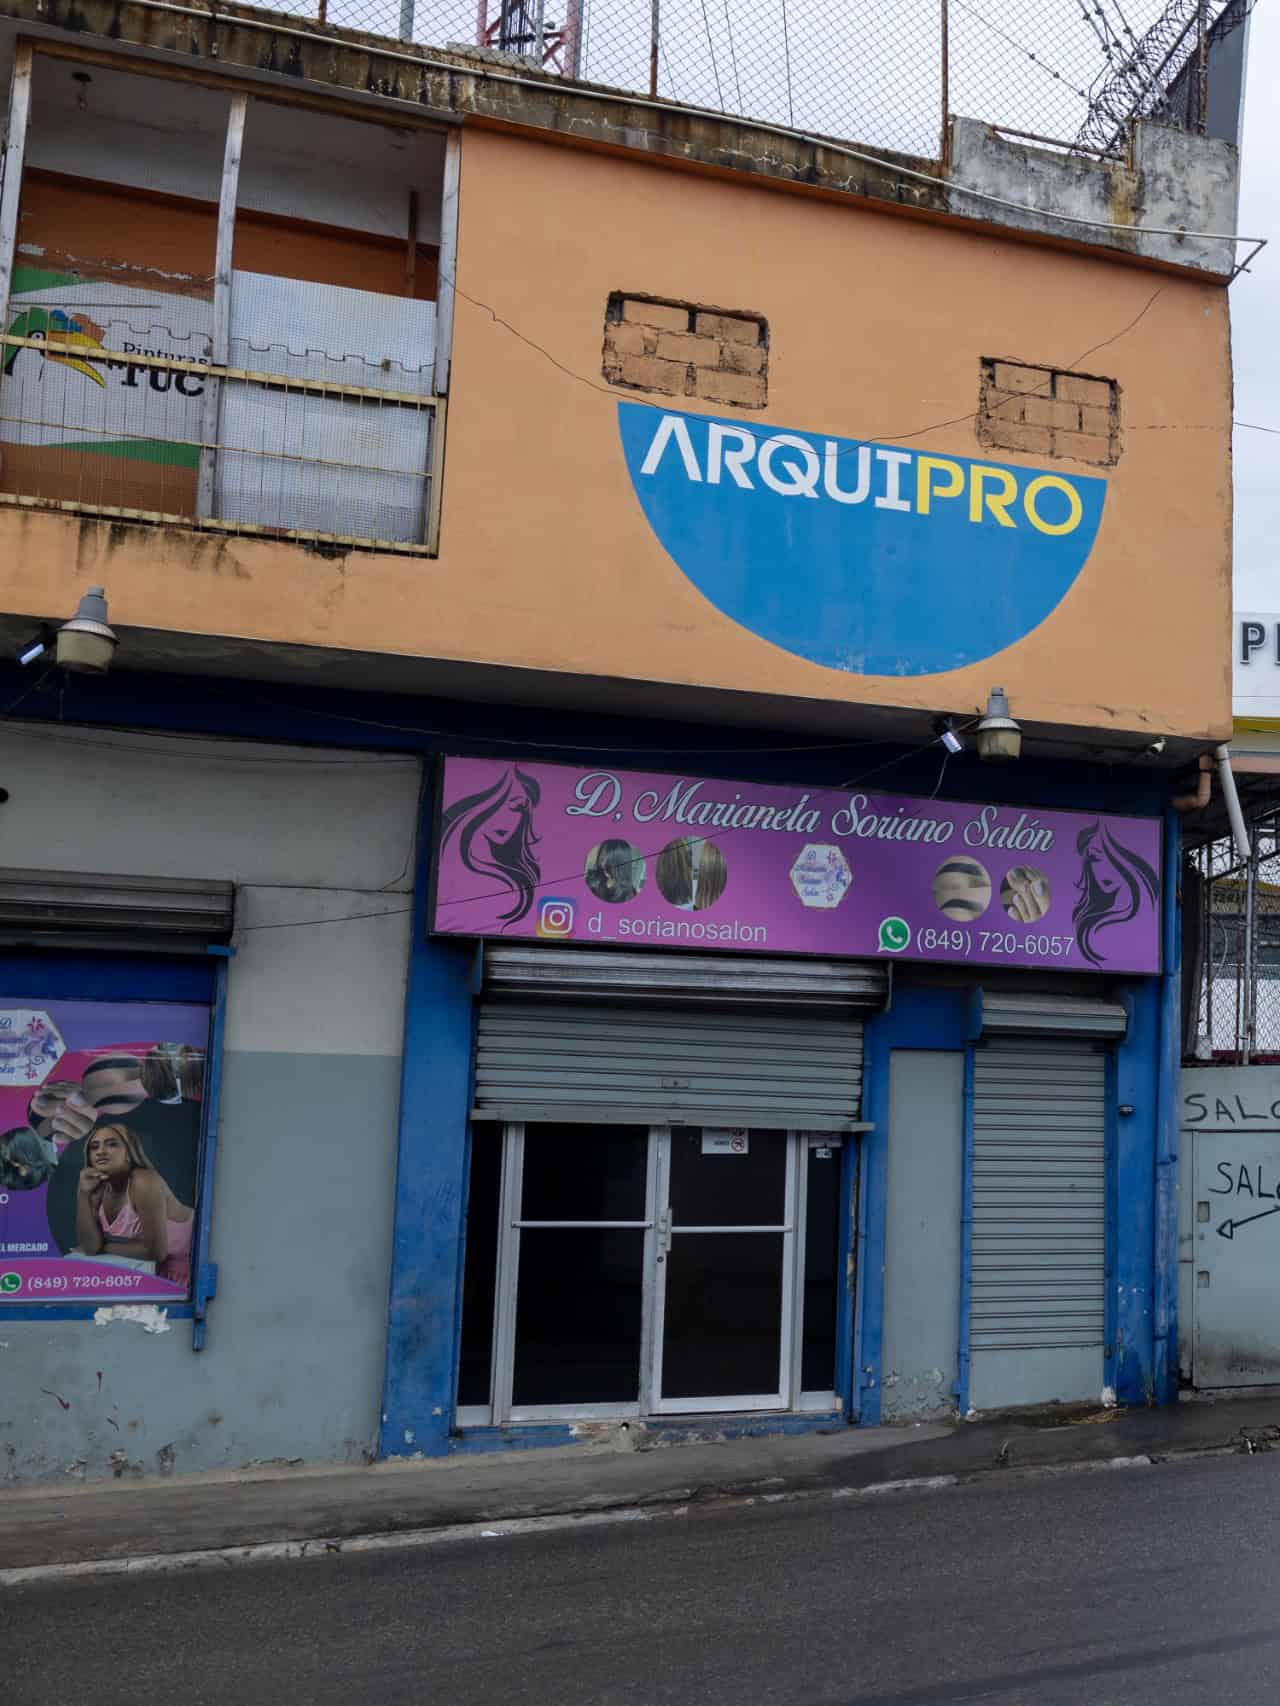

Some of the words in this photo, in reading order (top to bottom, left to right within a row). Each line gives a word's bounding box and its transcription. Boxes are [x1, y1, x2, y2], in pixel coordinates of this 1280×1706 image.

[640, 415, 1083, 536] ARQUIPRO
[566, 771, 625, 822] D.
[633, 779, 821, 833] Marianela
[831, 793, 955, 844] Soriano
[963, 805, 1056, 852] Salón
[916, 926, 973, 956] (849)
[979, 930, 1075, 957] 720-6057
[27, 1275, 68, 1291] (849)
[72, 1275, 143, 1289] 720-6057
